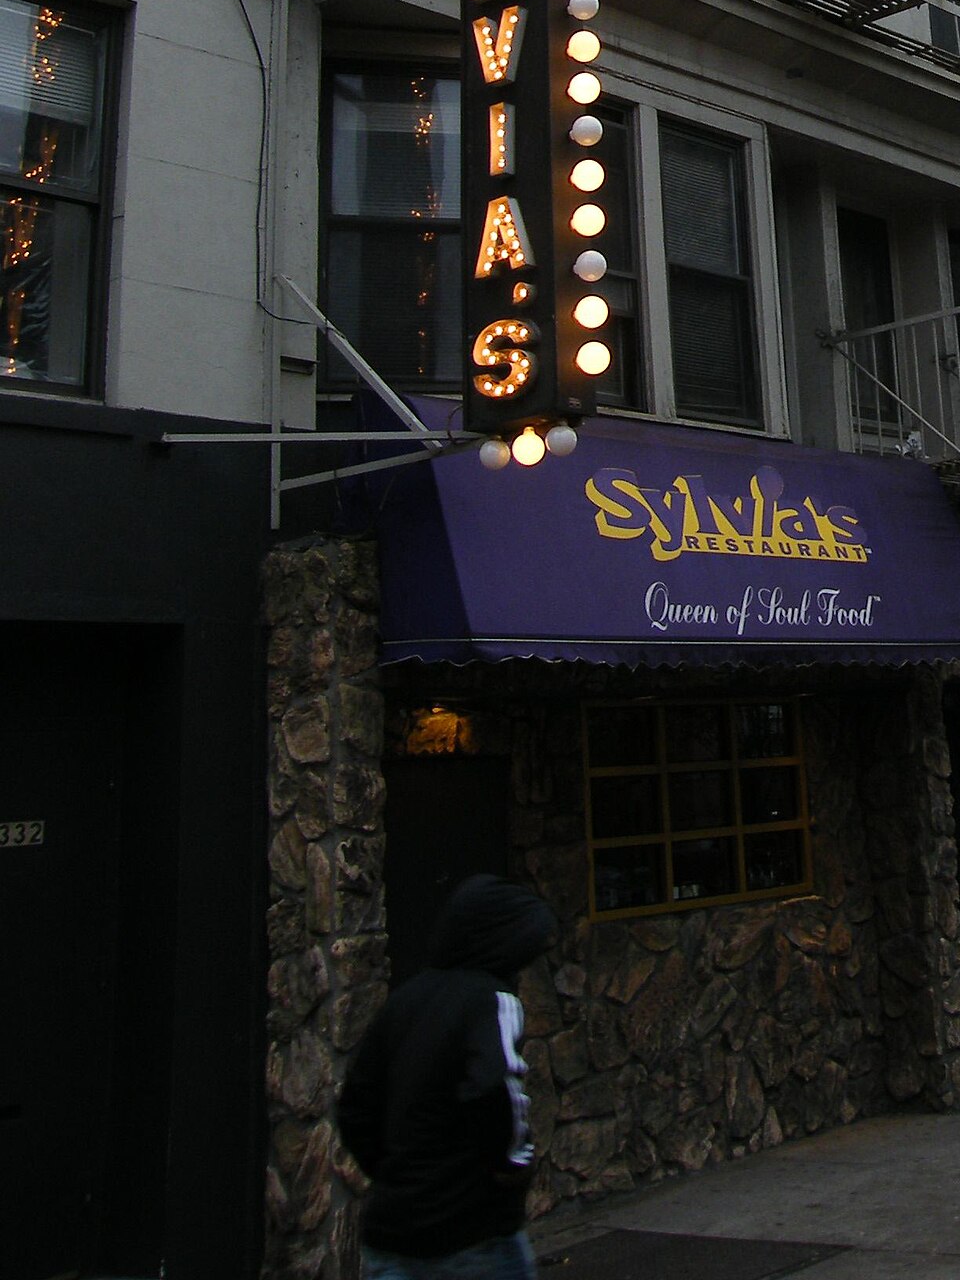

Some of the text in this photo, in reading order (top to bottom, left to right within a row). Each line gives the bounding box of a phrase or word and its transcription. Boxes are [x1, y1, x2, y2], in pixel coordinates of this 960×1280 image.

[686, 535, 864, 560] RESTAURANT
[644, 581, 875, 635] Queen of Soul Food
